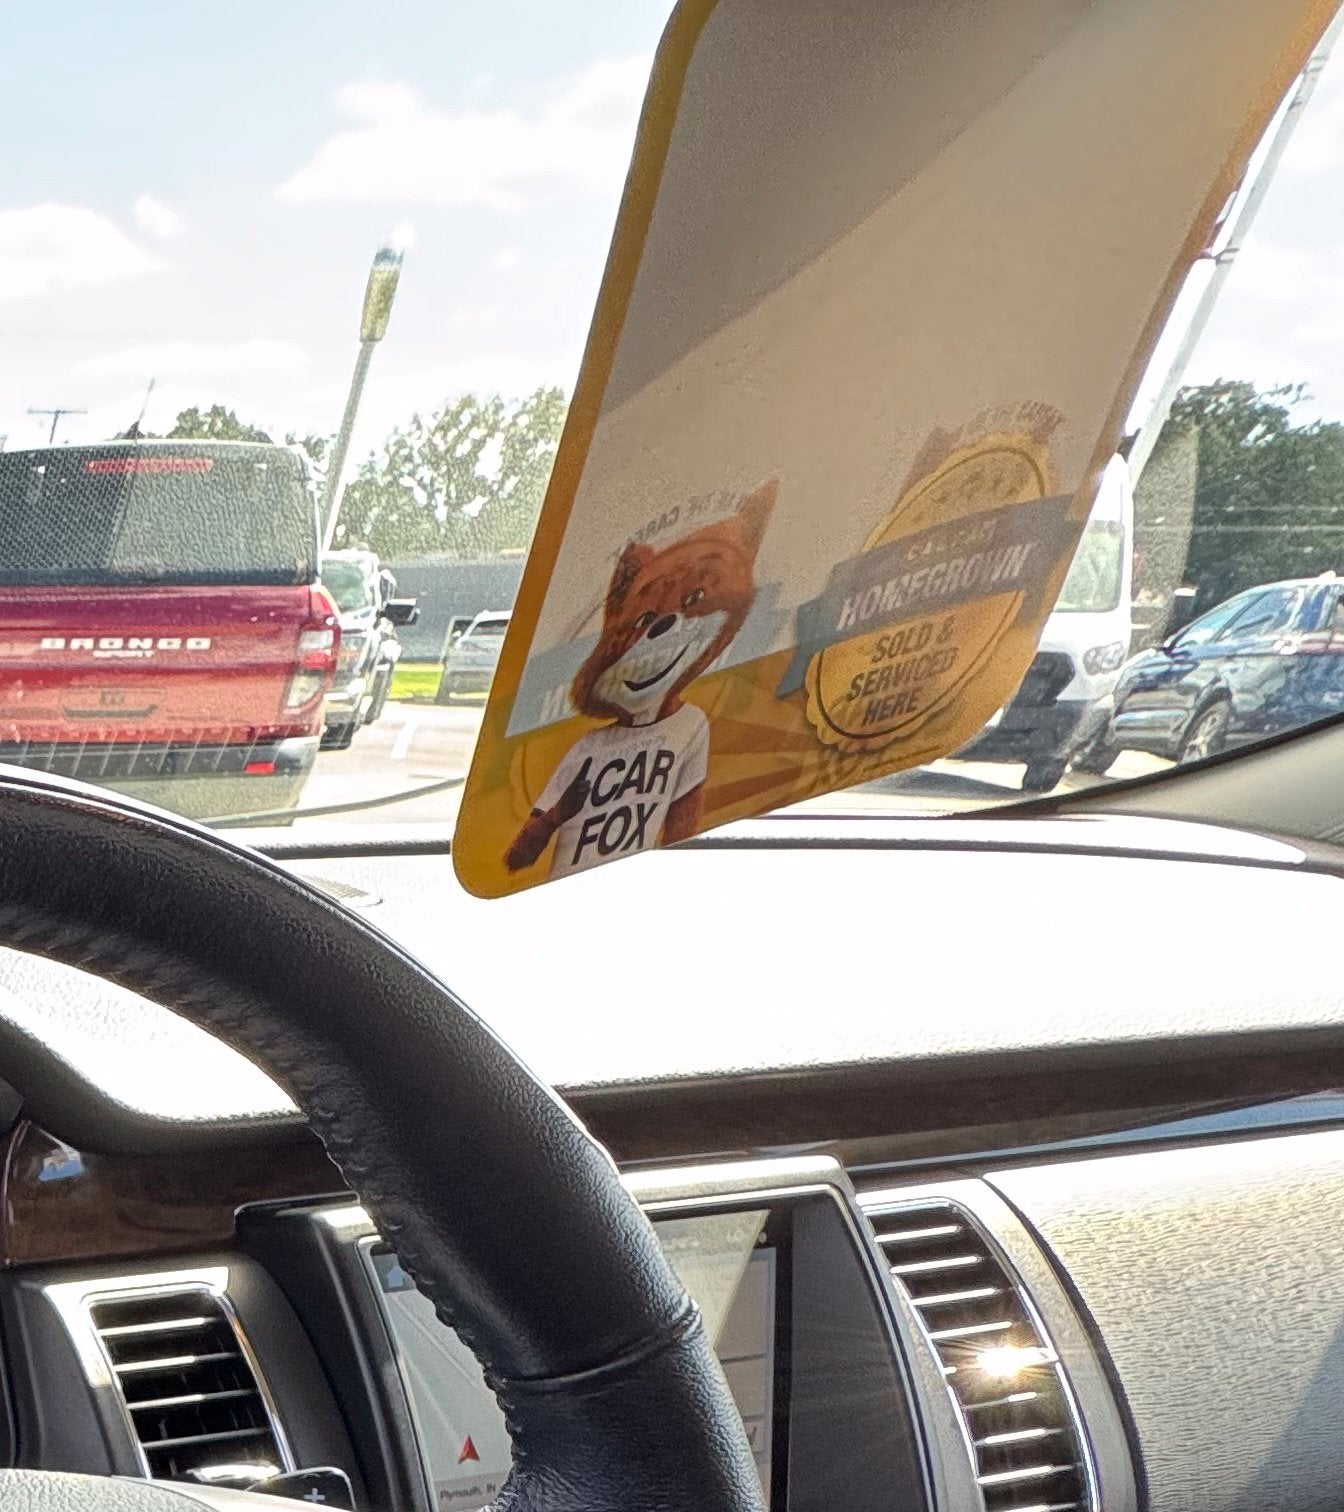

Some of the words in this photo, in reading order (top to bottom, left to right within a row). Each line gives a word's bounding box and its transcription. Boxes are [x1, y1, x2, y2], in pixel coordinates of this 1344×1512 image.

[40, 637, 211, 650] BRONCO
[872, 621, 930, 664] SOLD
[863, 691, 920, 727] HERE
[591, 750, 676, 808] CAR
[571, 802, 660, 866] FOX
